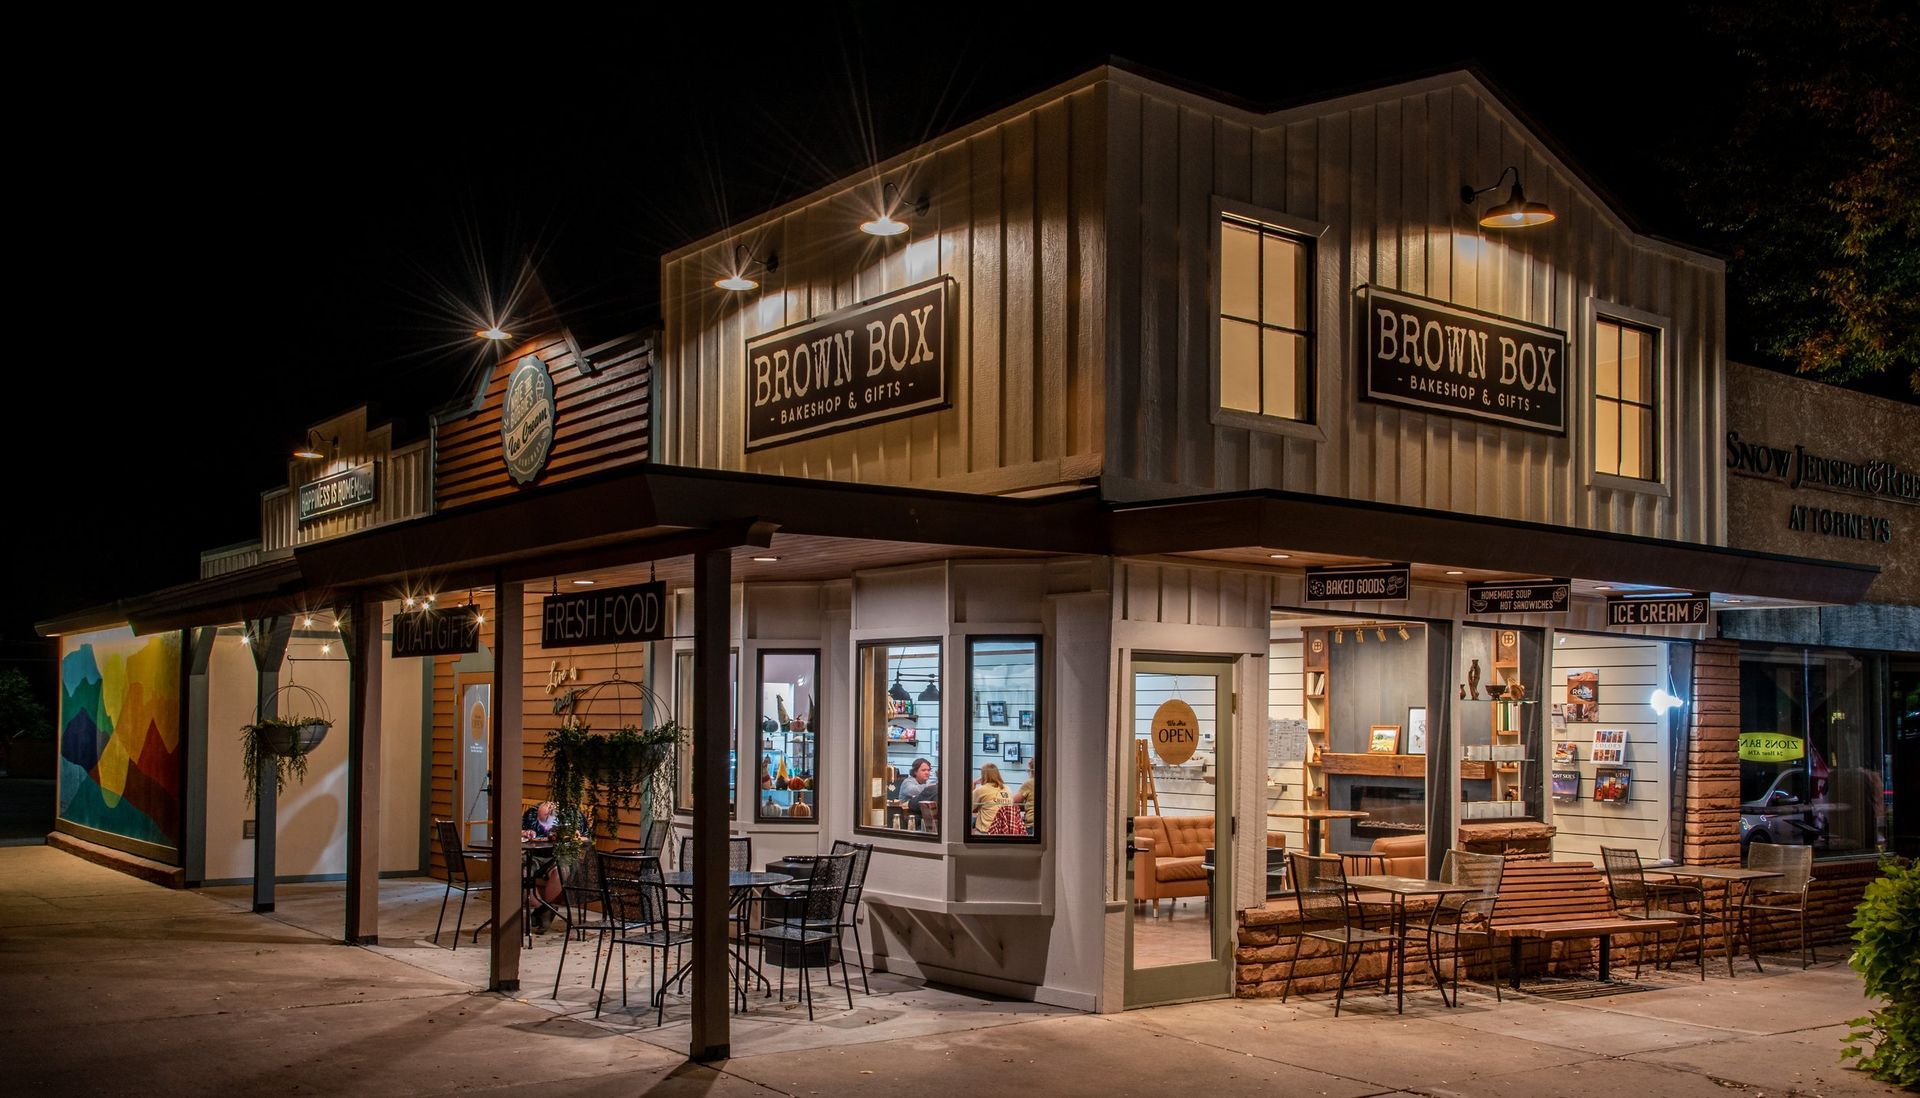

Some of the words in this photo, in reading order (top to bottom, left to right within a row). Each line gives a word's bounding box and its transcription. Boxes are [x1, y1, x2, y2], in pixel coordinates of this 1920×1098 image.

[754, 330, 854, 408] BROWN
[866, 304, 934, 378] BOX
[1377, 308, 1488, 380] BROWN
[1499, 337, 1556, 394] BOX
[781, 396, 841, 424] BAKESHOP
[848, 391, 857, 410] &
[865, 380, 901, 404] GIFTS
[1410, 375, 1475, 400] BAKESHOP
[1482, 389, 1491, 406] &
[1498, 393, 1530, 411] GIFTS
[508, 436, 520, 456] Ice
[522, 407, 548, 444] Cream
[1727, 431, 1793, 478] SNOW
[1790, 444, 1868, 491] JENSEN
[301, 482, 330, 516] HAPPINESS
[331, 482, 337, 504] IS
[1789, 504, 1893, 544] ATTORNEYS
[1326, 579, 1354, 595] BAKED
[1357, 578, 1386, 594] GOODS
[1481, 590, 1514, 600] HOMEMADE
[1515, 589, 1532, 599] SOUP
[1500, 601, 1512, 610] HOT
[1513, 599, 1553, 610] SANDWICHES
[545, 599, 598, 641] FRESH
[603, 592, 658, 636] FOOD
[1614, 604, 1635, 623] ICE
[1640, 602, 1689, 623] CREAM
[396, 615, 433, 653] UTAH
[437, 614, 474, 650] GIFTS
[545, 660, 567, 694] Live
[1158, 728, 1194, 743] OPEN
